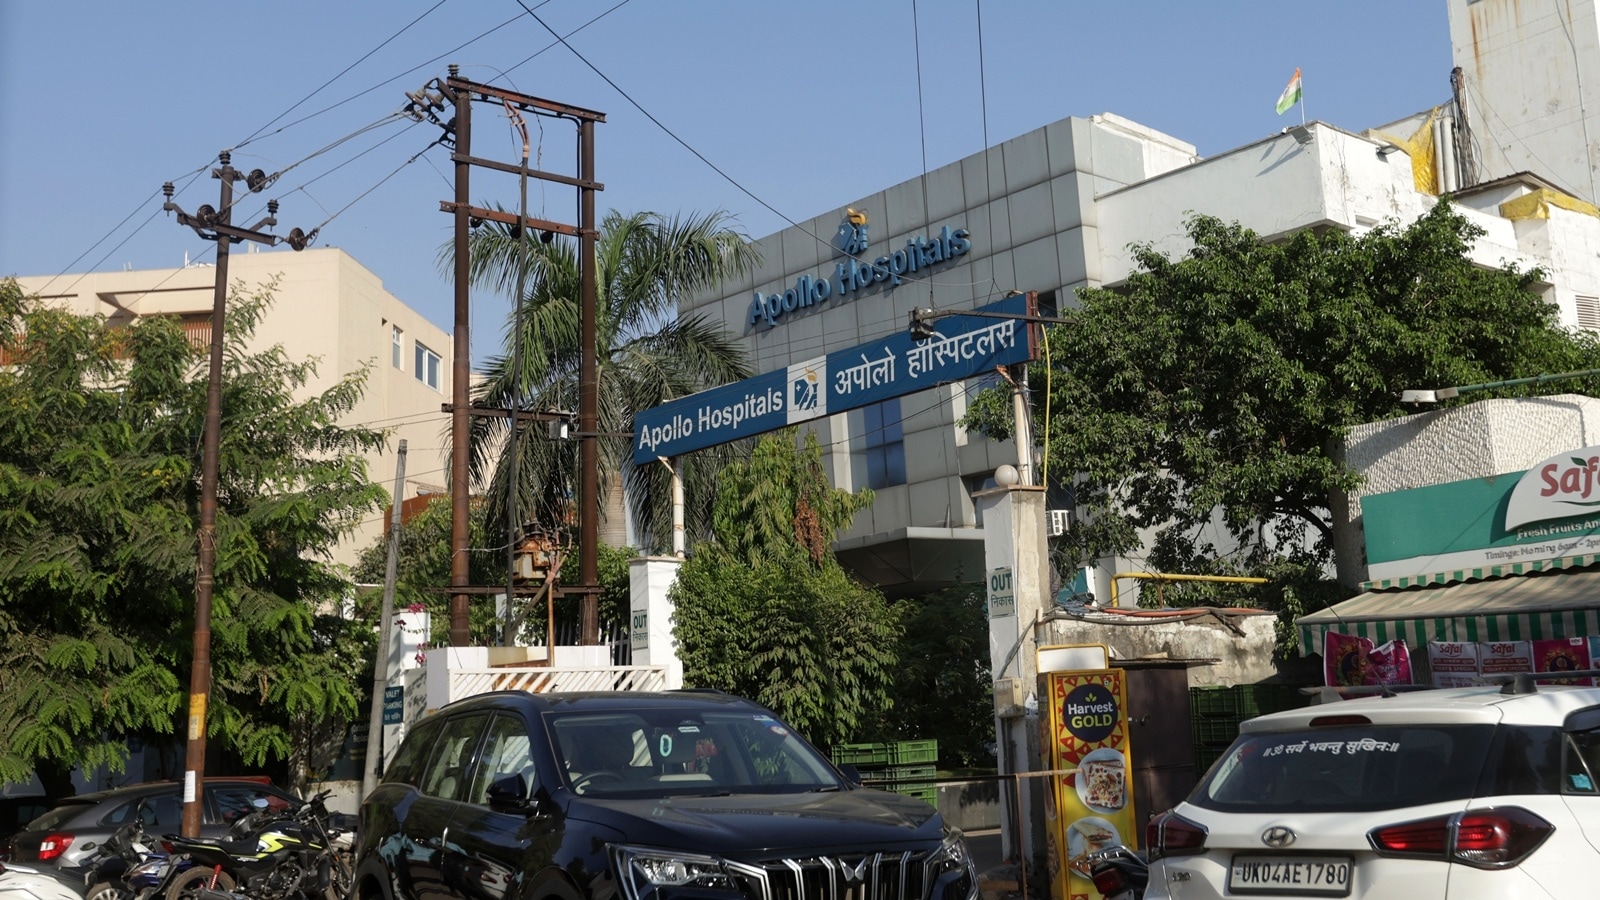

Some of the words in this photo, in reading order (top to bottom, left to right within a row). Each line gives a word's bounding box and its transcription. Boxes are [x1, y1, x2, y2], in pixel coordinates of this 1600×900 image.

[749, 273, 831, 327] Apollo
[837, 225, 972, 295] Hospitals
[835, 346, 897, 396] अपोलो
[907, 319, 1016, 379] हॉस्पिटलस
[638, 412, 694, 452] Apollo
[697, 387, 784, 433] Hospitals
[1540, 456, 1600, 499] Saf
[1516, 525, 1548, 541] Fresh
[1549, 521, 1582, 536] Fruits
[1583, 518, 1600, 531] An
[1484, 549, 1520, 561] Timings:
[1520, 543, 1557, 557] Morning
[991, 573, 1012, 592] OUT
[991, 595, 1014, 608] निकास
[634, 614, 647, 629] OUT
[1439, 642, 1463, 656] Safal
[1490, 642, 1516, 656] Safal
[385, 690, 400, 699] VALET
[1067, 701, 1114, 716] Harvest
[1071, 714, 1113, 729] GOLD
[1285, 739, 1308, 756] सर्वे
[1309, 740, 1344, 756] भवन्तु
[1242, 863, 1347, 884] UK04AE1780
